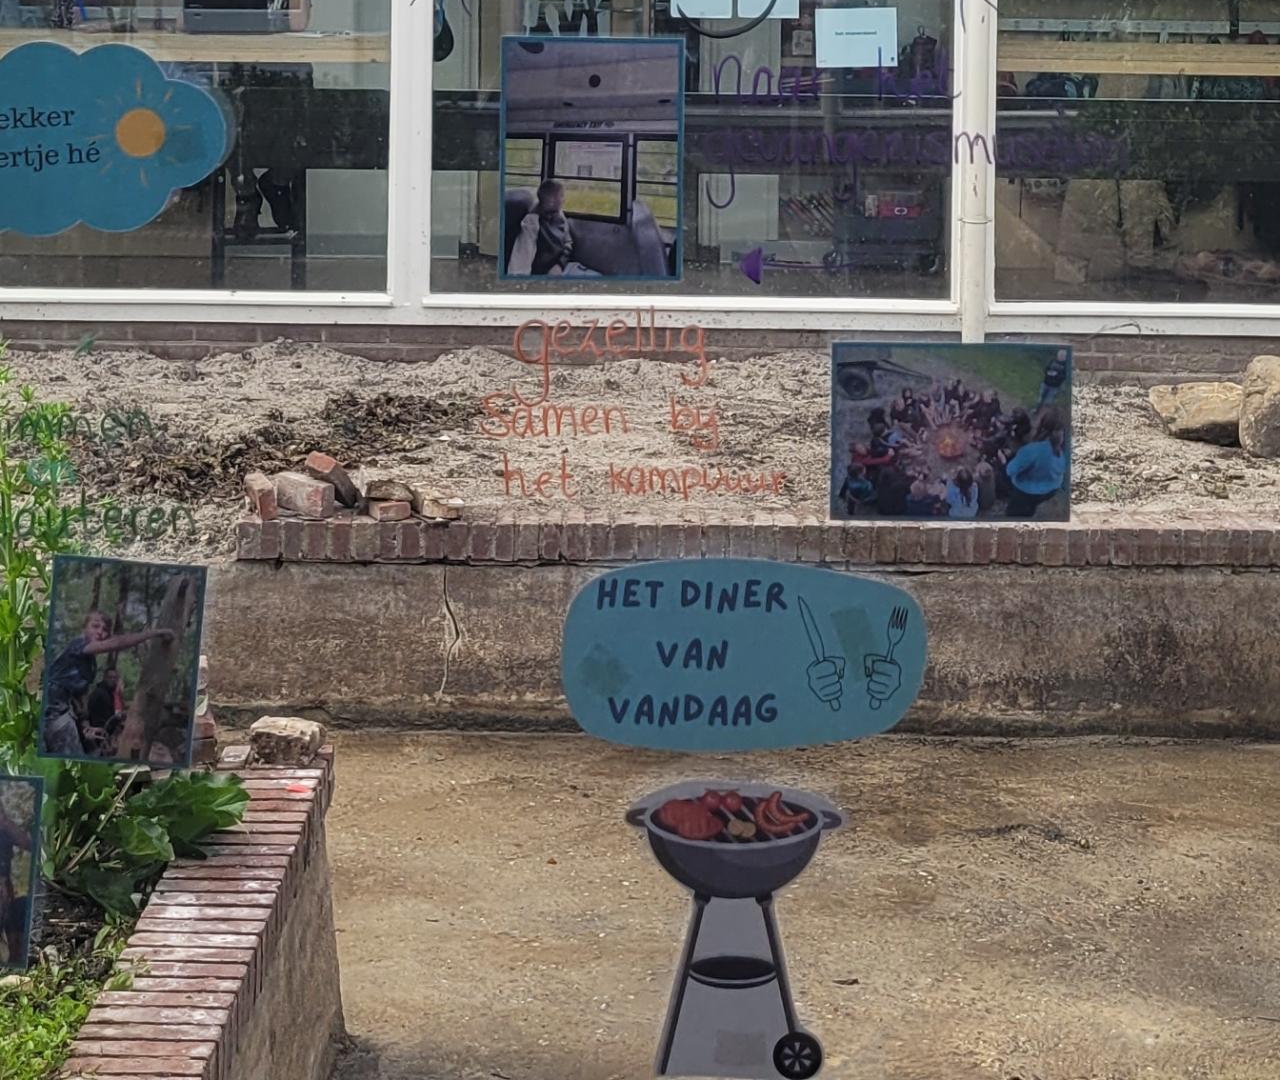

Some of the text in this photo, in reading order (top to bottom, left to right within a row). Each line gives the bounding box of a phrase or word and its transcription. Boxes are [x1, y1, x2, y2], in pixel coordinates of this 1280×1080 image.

[66, 139, 101, 164] hé
[513, 304, 709, 407] gezellig
[501, 452, 579, 499] het
[597, 578, 787, 612] HET DINER
[656, 638, 729, 670] VAN
[608, 694, 778, 725] VANDAAG
